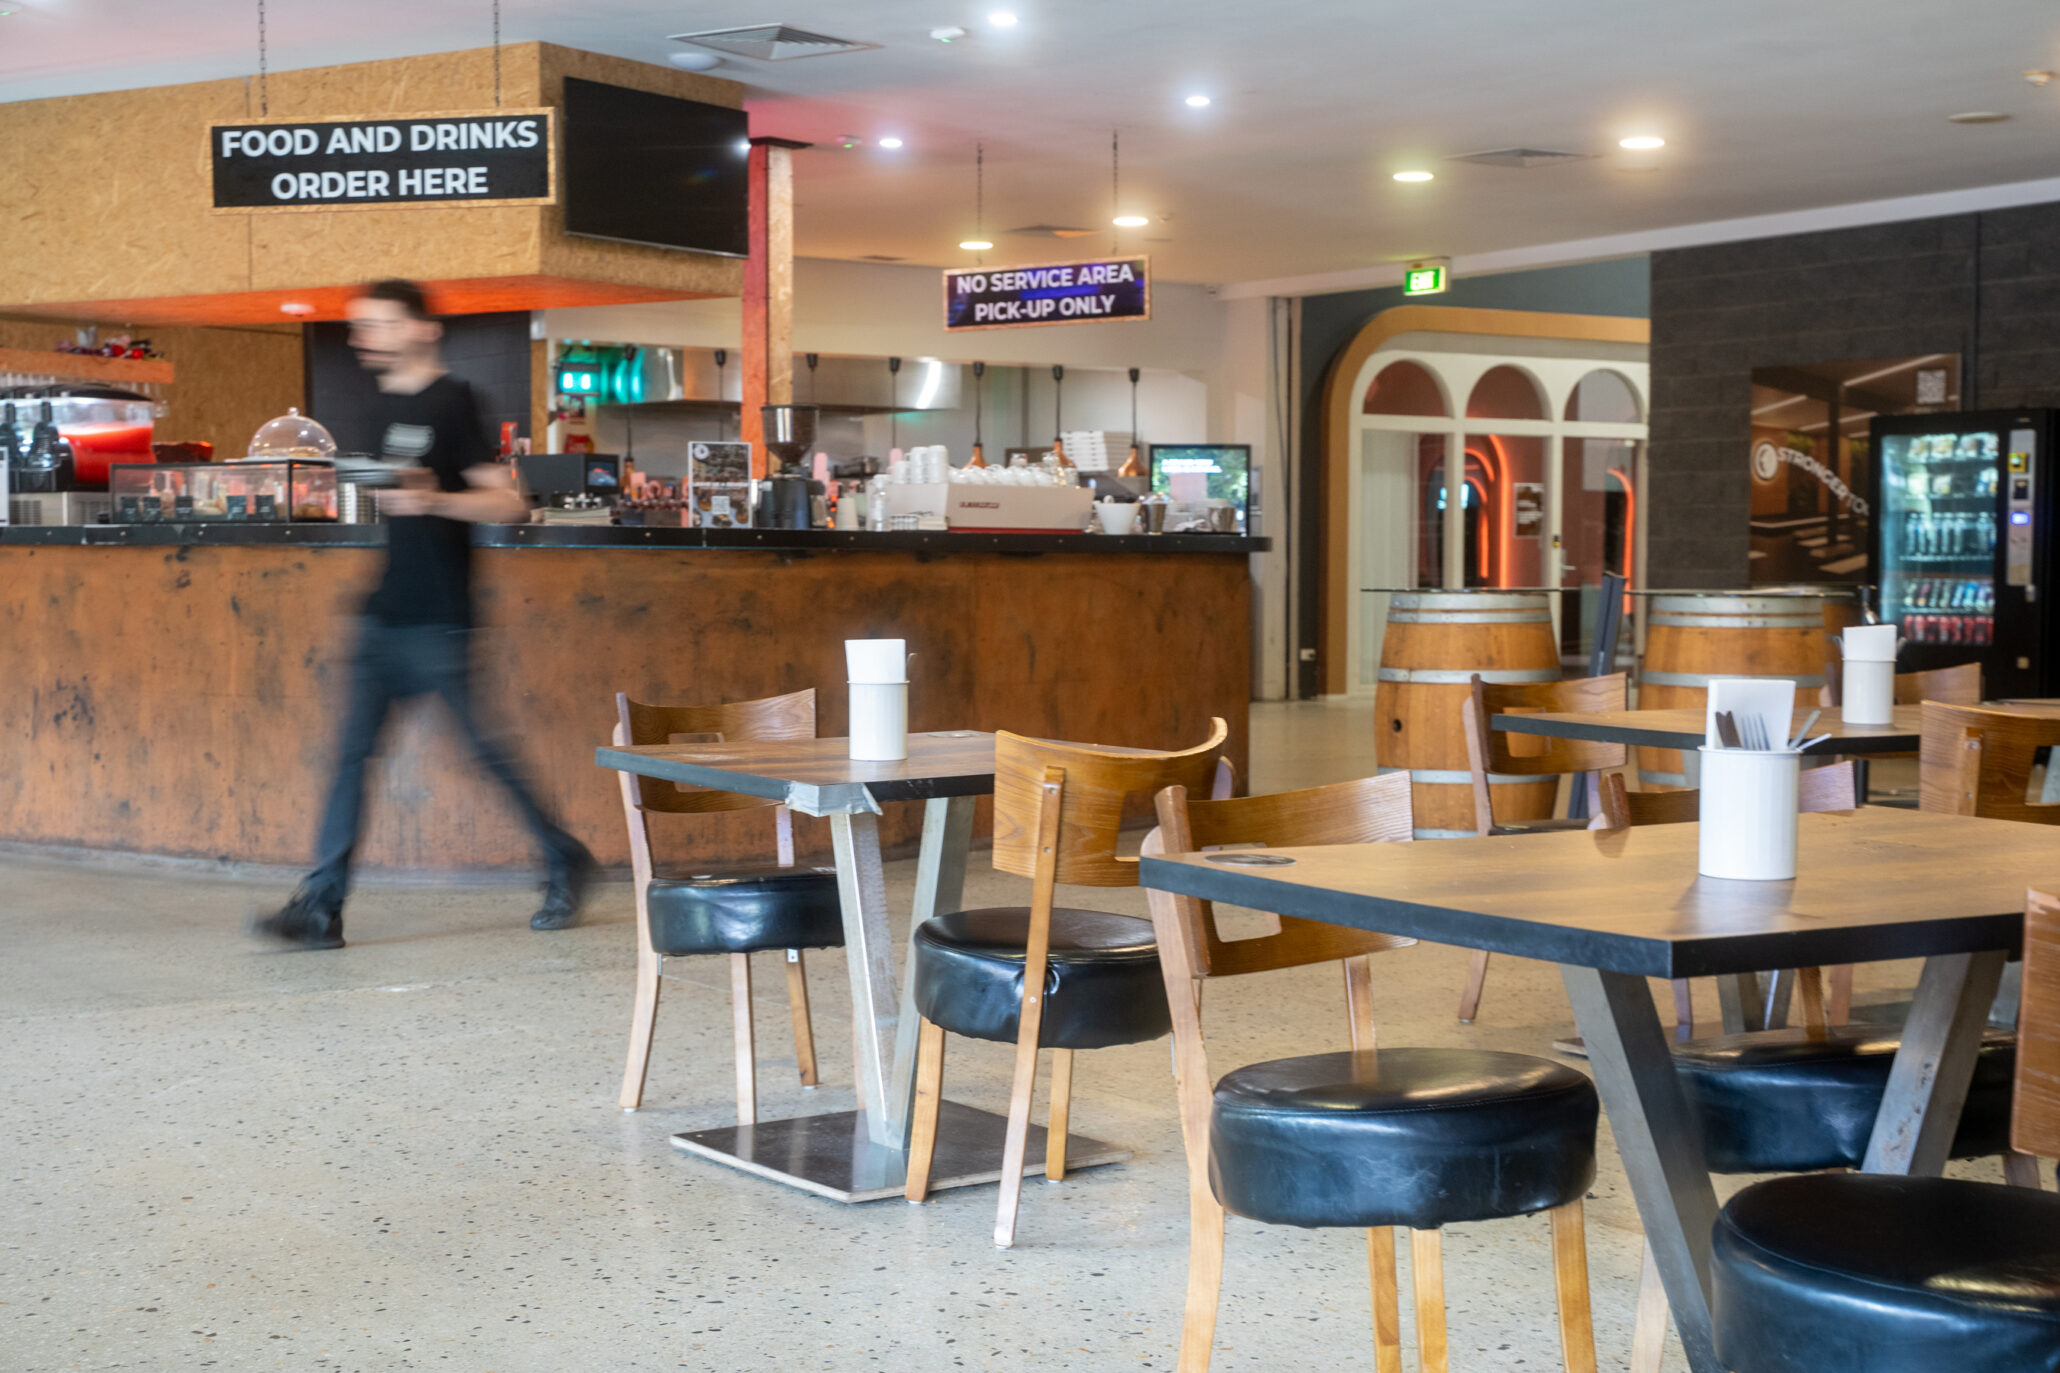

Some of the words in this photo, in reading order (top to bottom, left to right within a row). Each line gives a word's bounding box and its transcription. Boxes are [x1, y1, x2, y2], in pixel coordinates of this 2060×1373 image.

[221, 128, 320, 158] FOOD
[325, 126, 402, 154] AND
[409, 120, 539, 152] DRINKS
[271, 170, 390, 200] ORDER
[398, 166, 489, 196] HERE
[957, 274, 987, 294] NO
[990, 268, 1073, 292] SERVICE
[1077, 263, 1134, 286] AREA
[974, 298, 1055, 321] PICK-UP
[1059, 294, 1116, 316] ONLY
